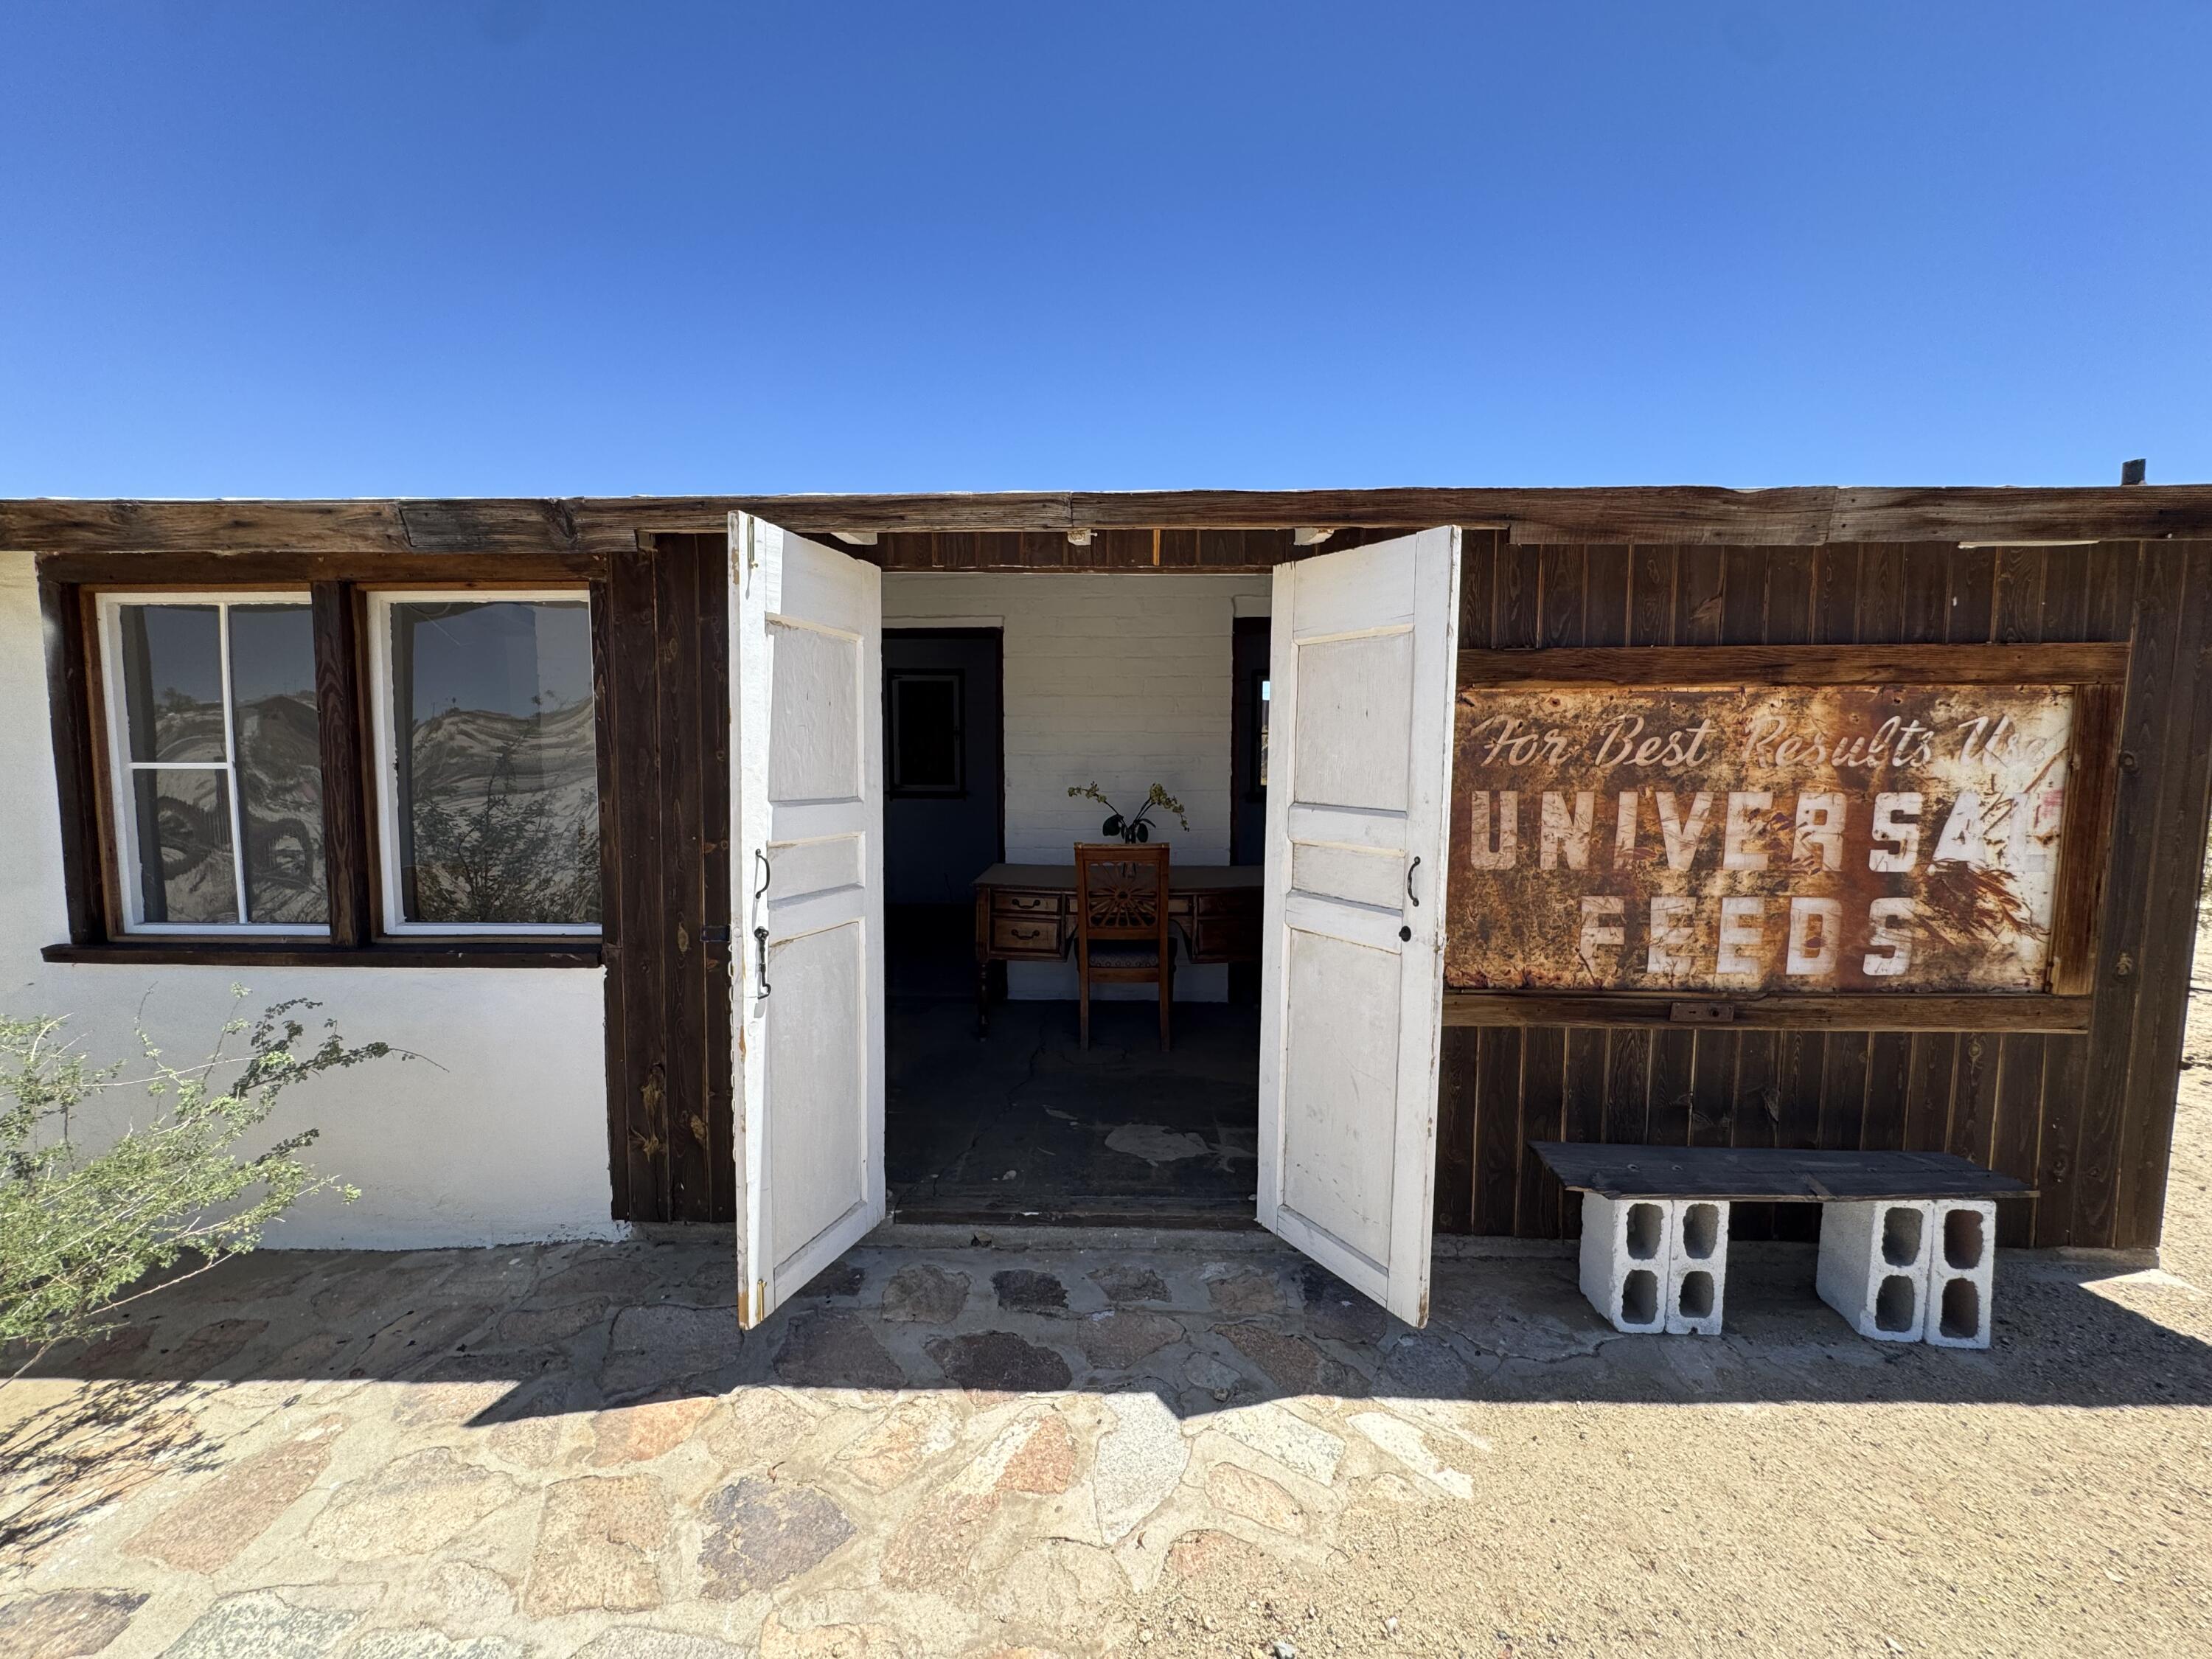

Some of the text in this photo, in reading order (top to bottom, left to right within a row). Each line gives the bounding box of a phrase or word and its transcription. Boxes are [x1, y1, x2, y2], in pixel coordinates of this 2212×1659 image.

[1471, 713, 2059, 768] For Best Results Use
[1471, 790, 2048, 873] UNIVERSAL
[1579, 895, 1917, 975] FEEDS
